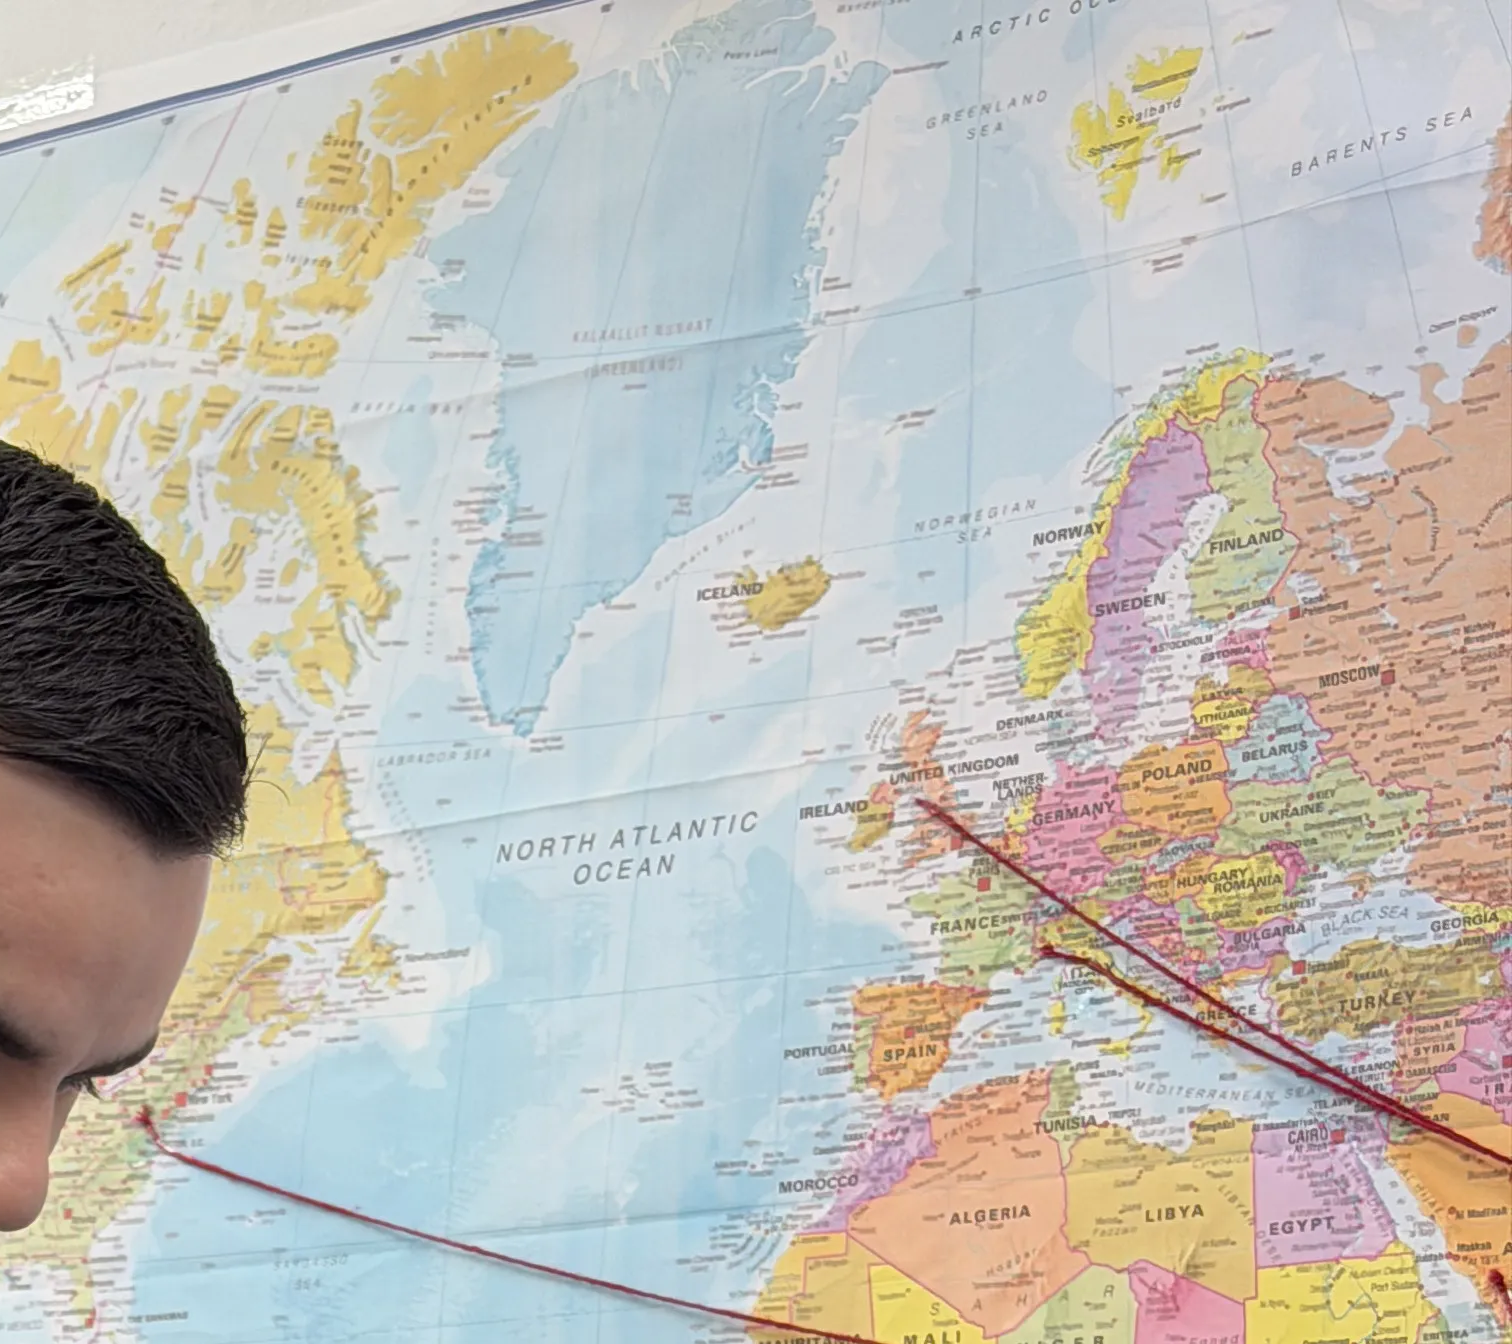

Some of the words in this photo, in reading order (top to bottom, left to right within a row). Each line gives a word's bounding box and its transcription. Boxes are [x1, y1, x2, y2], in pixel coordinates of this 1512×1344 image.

[952, 8, 1050, 45] ARCTIC
[926, 90, 1049, 130] GREENLAND
[966, 121, 1004, 141] SEA
[1291, 127, 1408, 177] BARENTS
[1425, 106, 1475, 133] SEA
[914, 499, 1036, 533] NORWEGIAN
[958, 526, 993, 545] SEA
[1033, 521, 1106, 547] NORWAY
[1209, 529, 1284, 554] FINLAND
[696, 583, 764, 602] ICELAND
[1095, 592, 1167, 617] SWEDEN
[1318, 664, 1381, 690] MOSCOW
[995, 709, 1065, 732] DENMARK
[1241, 741, 1308, 763] BELARUS
[889, 765, 944, 786] UNITED
[947, 753, 1020, 777] KINGDOM
[1141, 758, 1213, 783] POLAND
[992, 772, 1049, 791] NETHER-
[997, 785, 1043, 801] LANDS
[799, 800, 869, 820] IRELAND
[1032, 801, 1116, 828] GERMANY
[1259, 801, 1325, 824] UKRAINE
[496, 833, 598, 865] NORTH
[609, 810, 760, 850] ATLANTIC
[573, 854, 675, 885] OCEAN
[1176, 867, 1248, 889] HUNGARY
[1213, 874, 1283, 894] ROMANIA
[930, 915, 1000, 936] FRANCE
[1321, 908, 1374, 937] BLACK
[1378, 905, 1409, 921] SEA
[1431, 911, 1500, 933] GEORGIA
[1234, 922, 1307, 946] BULGARIA
[1338, 990, 1417, 1014] TURKEY
[784, 1043, 856, 1060] PORTUGAL
[883, 1044, 937, 1062] SPAIN
[1413, 1042, 1456, 1057] SYRIA
[1134, 1080, 1277, 1102] MEDITERRANEAN
[1033, 1114, 1097, 1135] TUNISIA
[1287, 1127, 1329, 1147] CAIRO
[778, 1174, 859, 1194] MOROCCO
[949, 1203, 1032, 1227] ALGERIA
[1144, 1202, 1206, 1225] LIBYA
[1269, 1215, 1335, 1236] EGYPT
